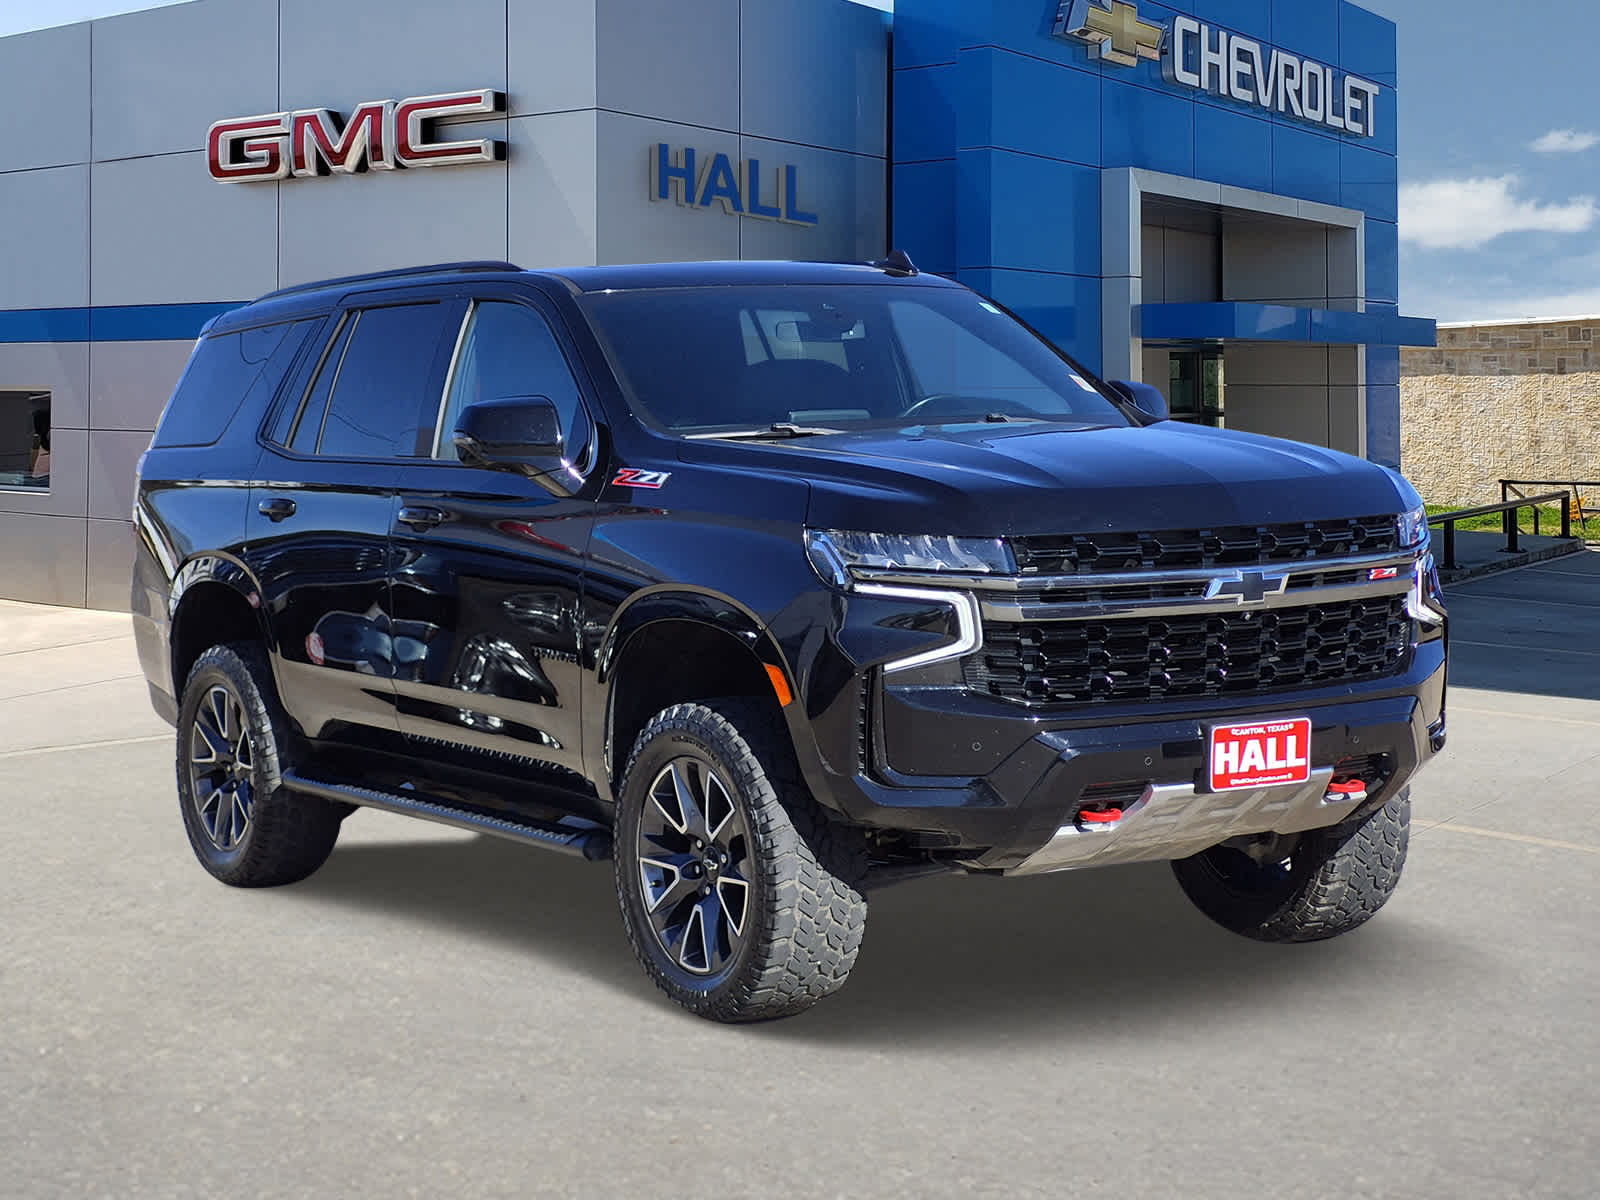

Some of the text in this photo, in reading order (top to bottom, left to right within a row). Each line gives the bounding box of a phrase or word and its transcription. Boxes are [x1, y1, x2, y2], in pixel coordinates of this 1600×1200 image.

[1173, 15, 1380, 137] CHEVROLET
[206, 88, 502, 183] GMC
[653, 143, 818, 226] HALL
[611, 467, 673, 489] Z71
[1214, 735, 1306, 775] HALL
